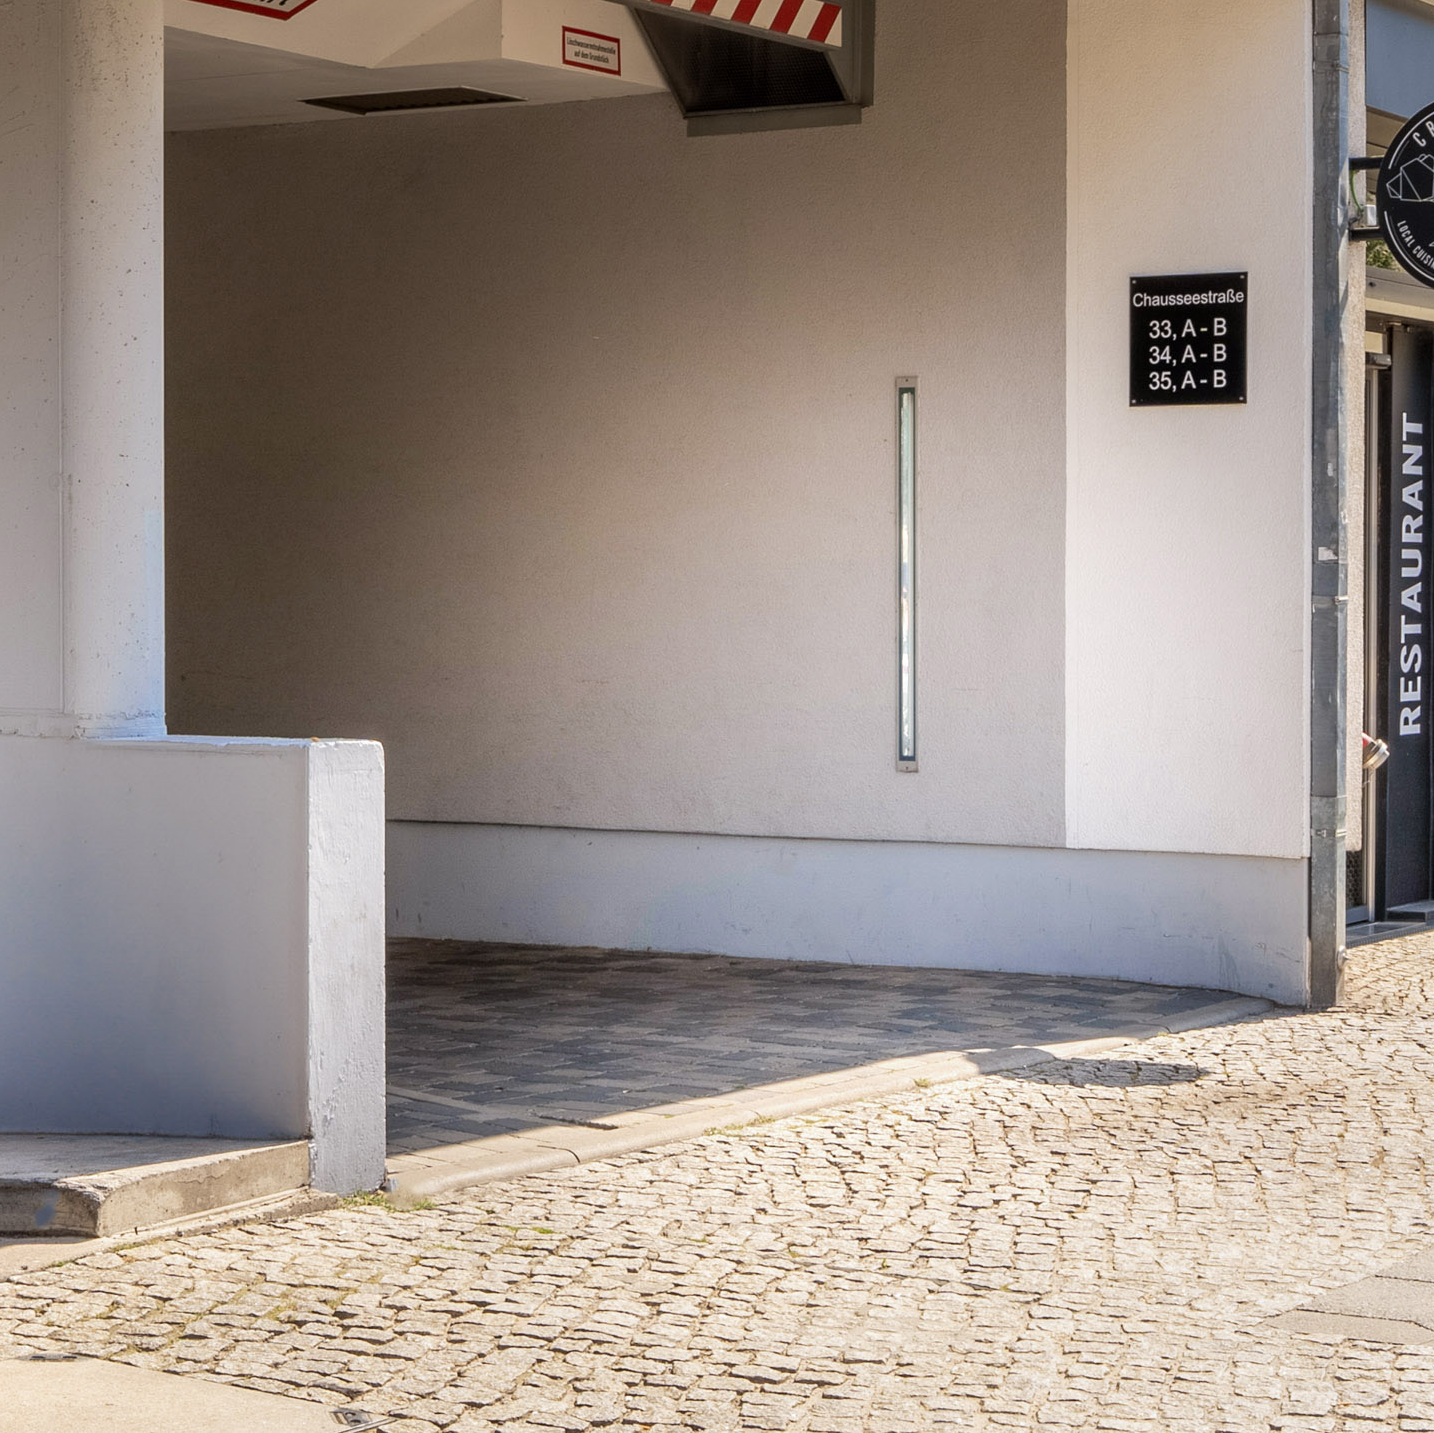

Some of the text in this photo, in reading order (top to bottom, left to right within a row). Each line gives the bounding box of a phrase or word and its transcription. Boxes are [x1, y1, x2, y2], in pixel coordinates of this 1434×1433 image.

[1397, 220, 1416, 248] LOCAL
[1132, 288, 1244, 307] Chausseestraße
[1149, 320, 1178, 341] 33,
[1181, 319, 1197, 338] A
[1213, 317, 1227, 336] B
[1149, 346, 1178, 367] 34,
[1181, 345, 1197, 364] A
[1213, 343, 1227, 362] B
[1149, 372, 1178, 393] 35,
[1181, 371, 1197, 390] A
[1213, 369, 1227, 388] B
[1398, 412, 1424, 736] RESTAURANT
